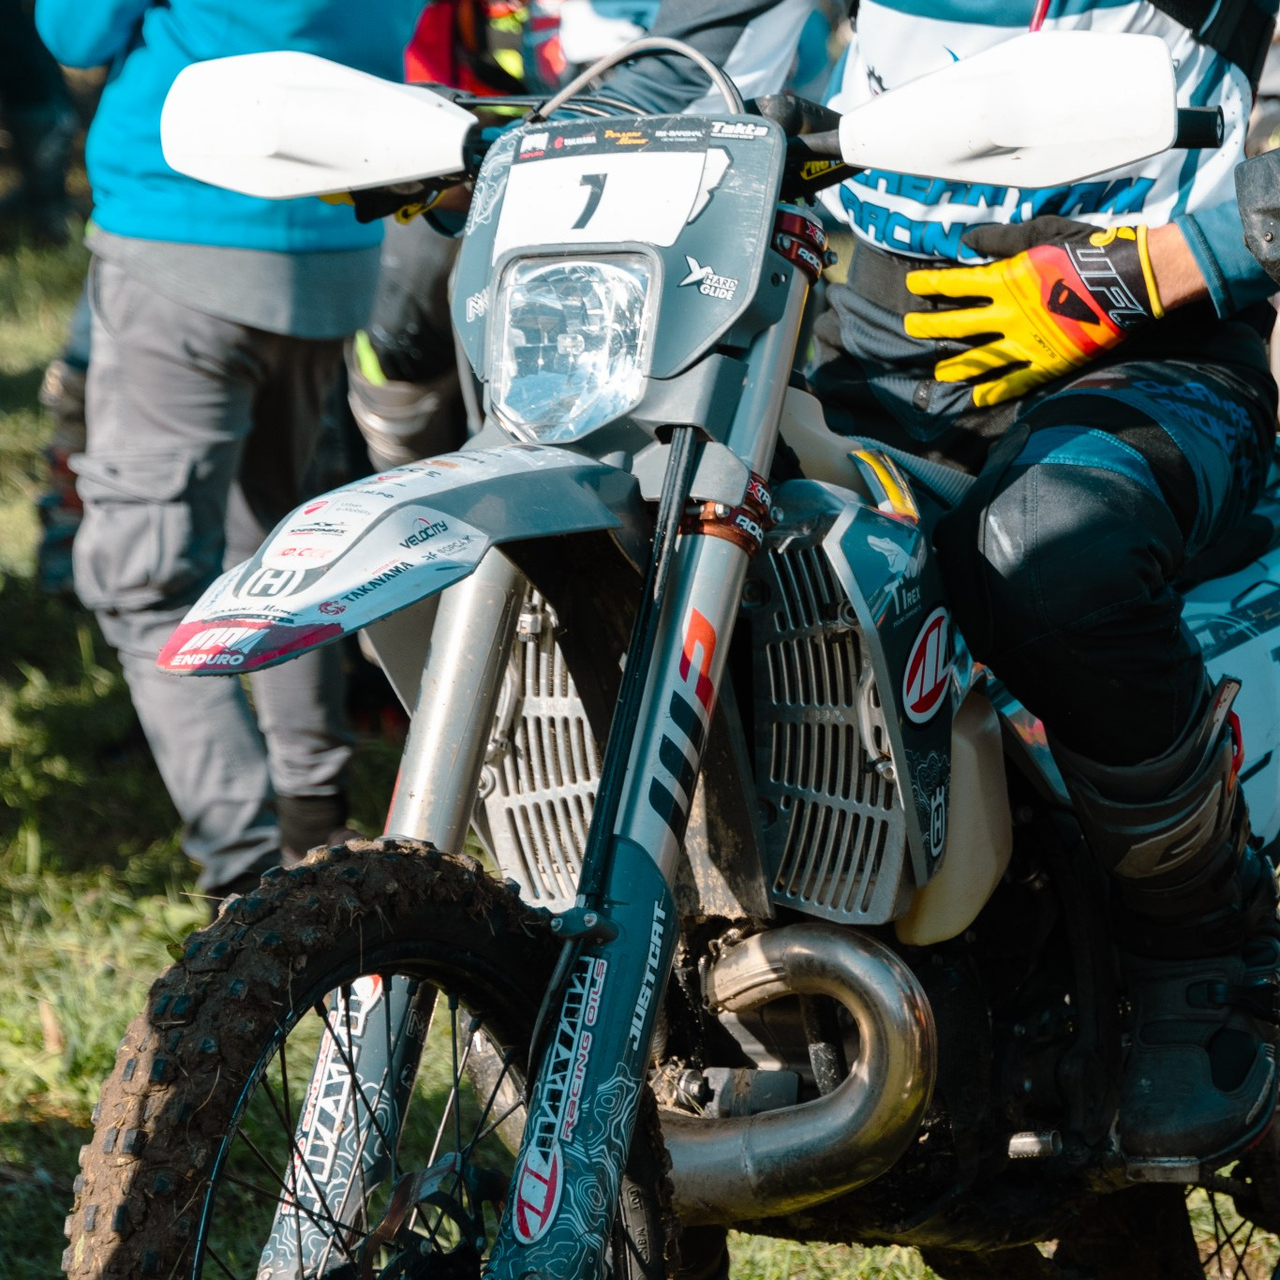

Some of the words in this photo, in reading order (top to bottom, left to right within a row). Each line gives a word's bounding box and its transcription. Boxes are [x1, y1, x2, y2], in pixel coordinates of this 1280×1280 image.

[703, 274, 739, 290] HARD
[700, 284, 736, 300] GLIDE
[399, 519, 449, 550] VELOCITY
[341, 560, 415, 603] TAKAYAMA
[171, 652, 245, 667] ENDURO
